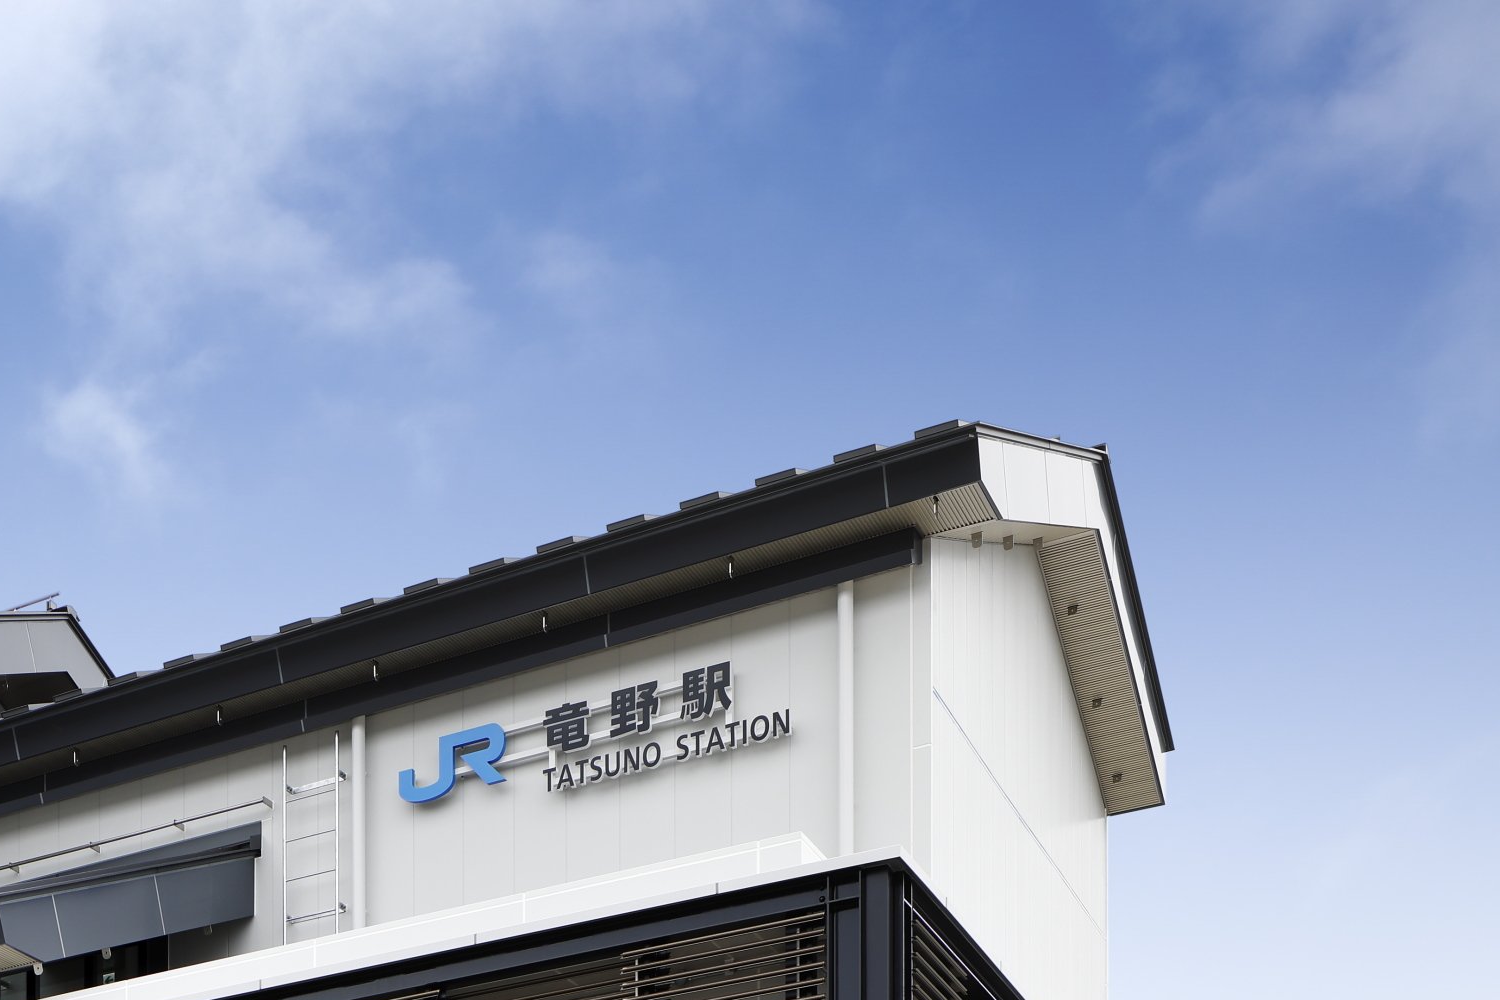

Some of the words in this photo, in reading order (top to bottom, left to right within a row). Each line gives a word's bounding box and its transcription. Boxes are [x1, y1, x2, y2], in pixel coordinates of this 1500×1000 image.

[543, 660, 733, 751] 竜野駅
[398, 722, 507, 803] JR
[542, 741, 662, 793] TATSUNO
[676, 709, 791, 761] STATION
